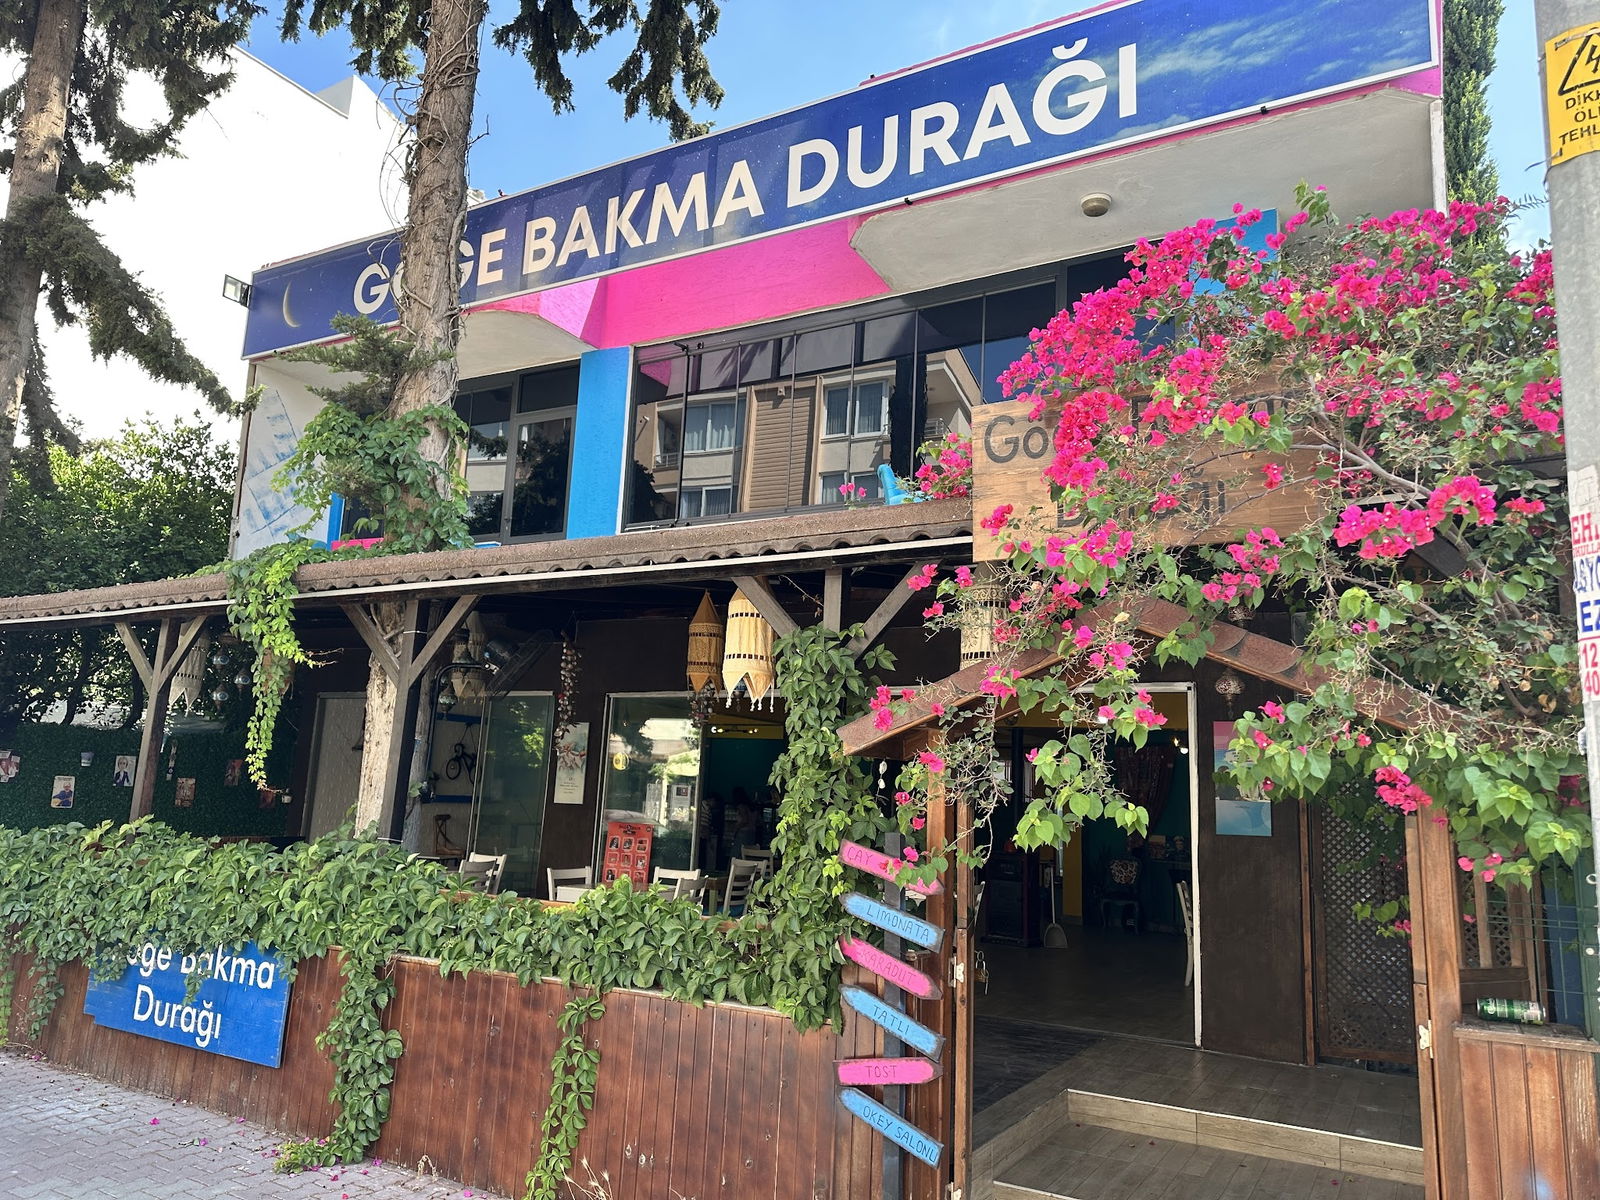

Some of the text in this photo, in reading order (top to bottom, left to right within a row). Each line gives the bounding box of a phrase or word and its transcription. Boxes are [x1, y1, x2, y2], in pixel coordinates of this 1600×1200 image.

[1574, 102, 1600, 122] ÖL
[353, 36, 1137, 315] GE BAKMA DURAĞI
[133, 983, 222, 1048] Durağı
[873, 1004, 910, 1035] TATLI
[865, 1065, 897, 1078] TOST
[863, 1105, 938, 1163] OKEY SALONU
